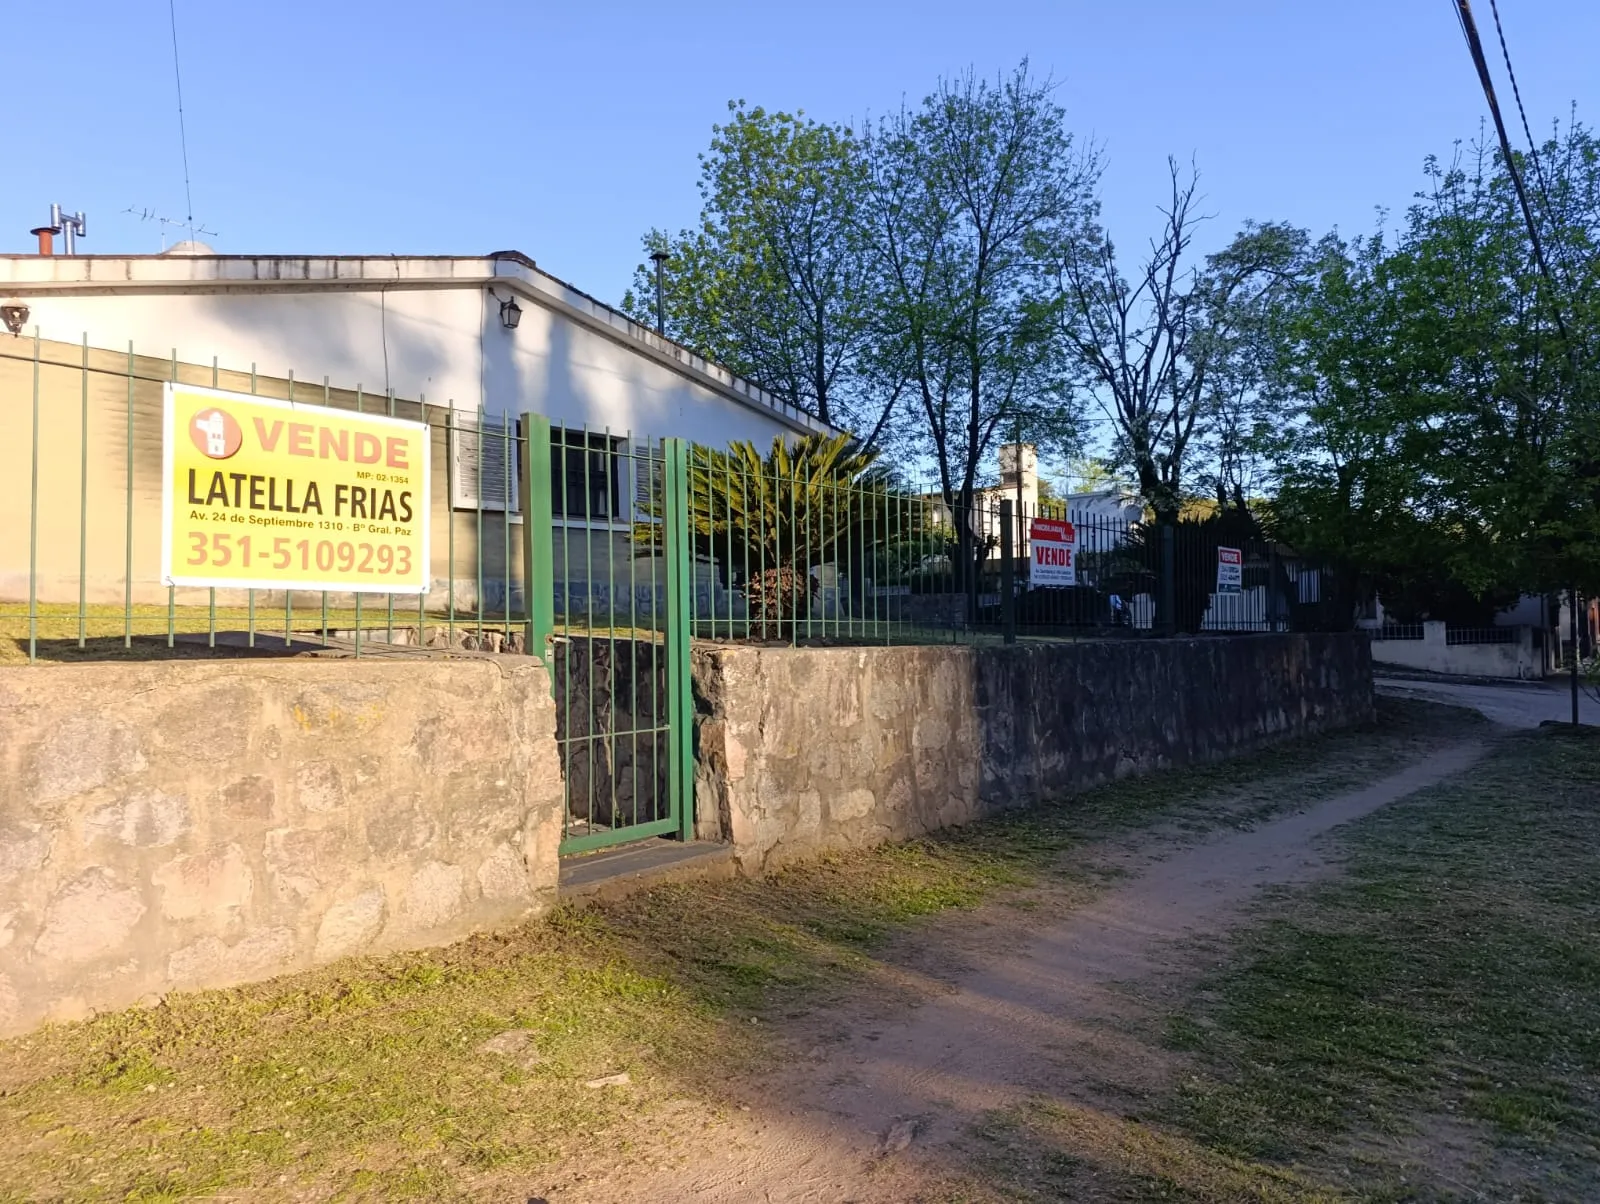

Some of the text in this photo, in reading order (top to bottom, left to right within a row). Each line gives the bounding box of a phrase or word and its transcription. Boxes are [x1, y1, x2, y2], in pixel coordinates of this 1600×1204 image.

[252, 416, 409, 470] VENDE
[356, 471, 409, 484] MP: 02-1354
[188, 468, 413, 523] LATELLA FRIAS
[190, 510, 208, 520] Av.
[212, 512, 226, 521] 24
[230, 513, 245, 523] de
[248, 515, 314, 528] Septiembre
[319, 521, 343, 531] 1310
[368, 524, 392, 534] Gral.
[395, 526, 412, 536] Paz
[187, 531, 412, 576] 351-5109293
[1036, 546, 1071, 567] VENDE
[1221, 551, 1238, 563] VENDE
